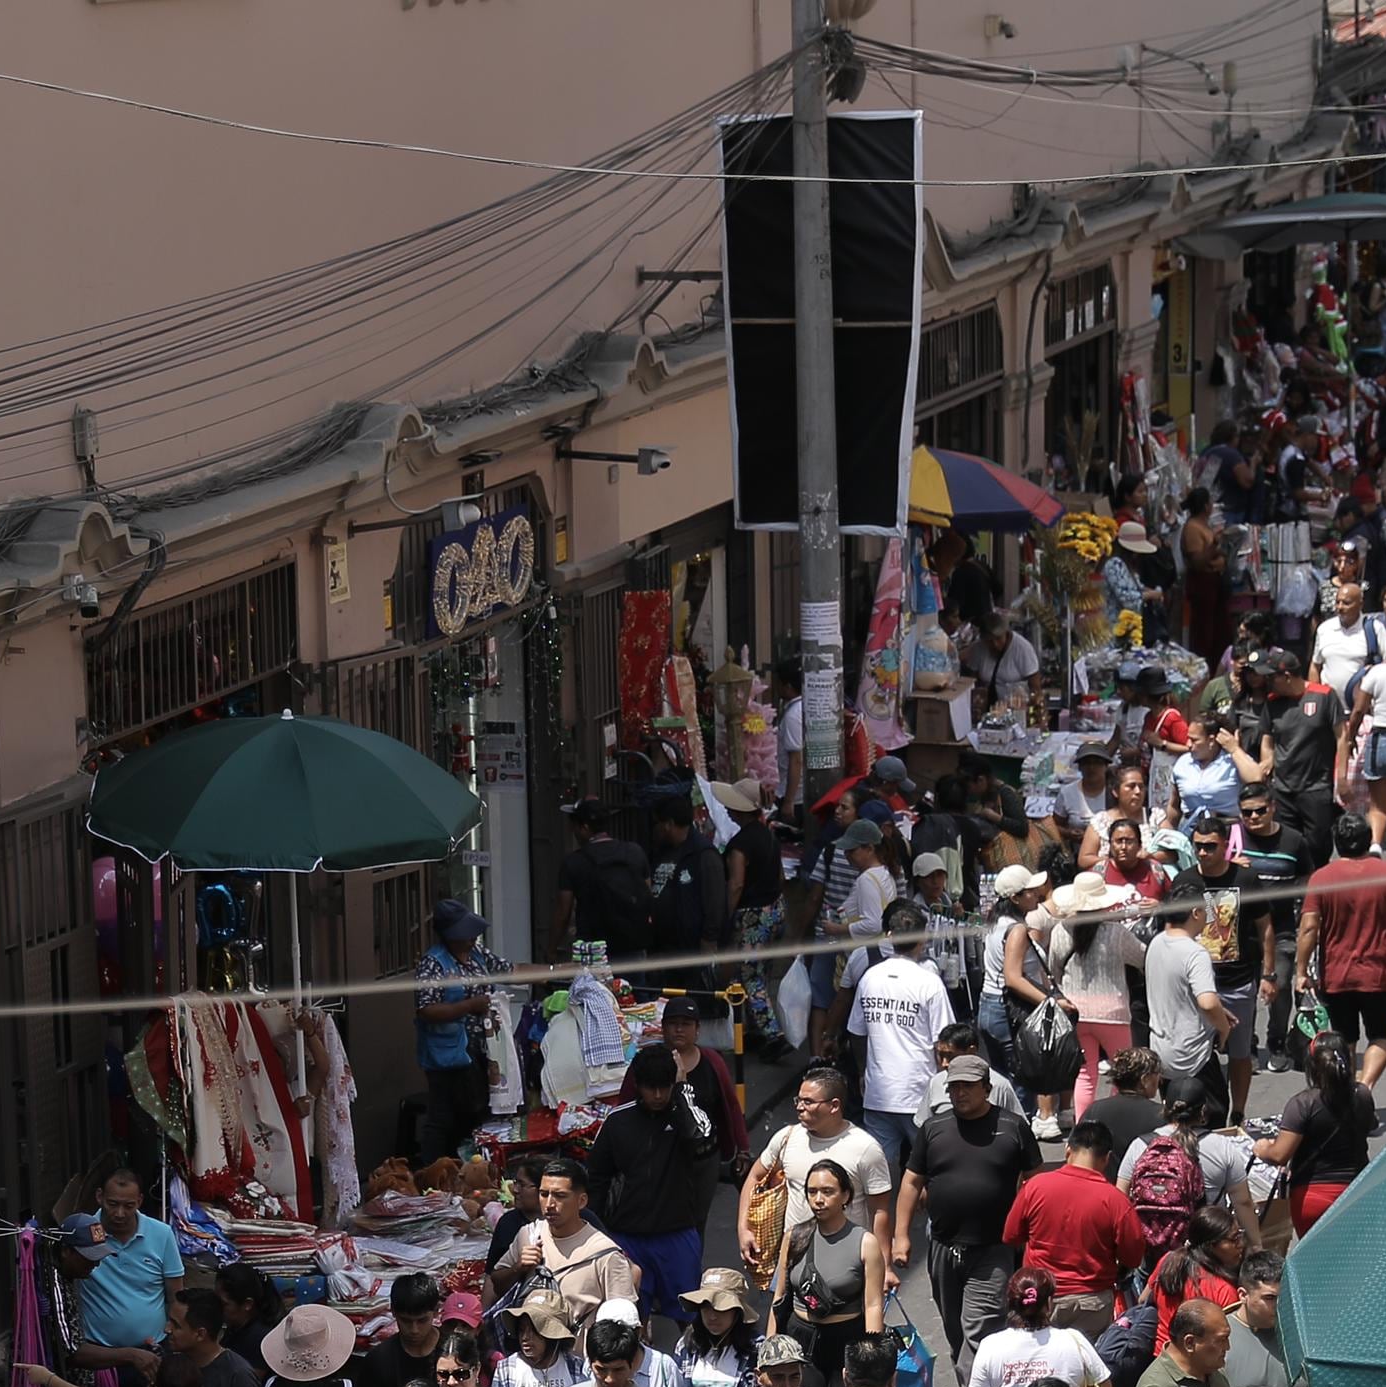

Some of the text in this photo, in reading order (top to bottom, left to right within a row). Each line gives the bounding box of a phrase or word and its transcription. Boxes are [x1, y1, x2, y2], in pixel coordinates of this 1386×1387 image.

[861, 997, 920, 1015] ESSENTIALS
[864, 1011, 915, 1028] FEAR OF GOD
